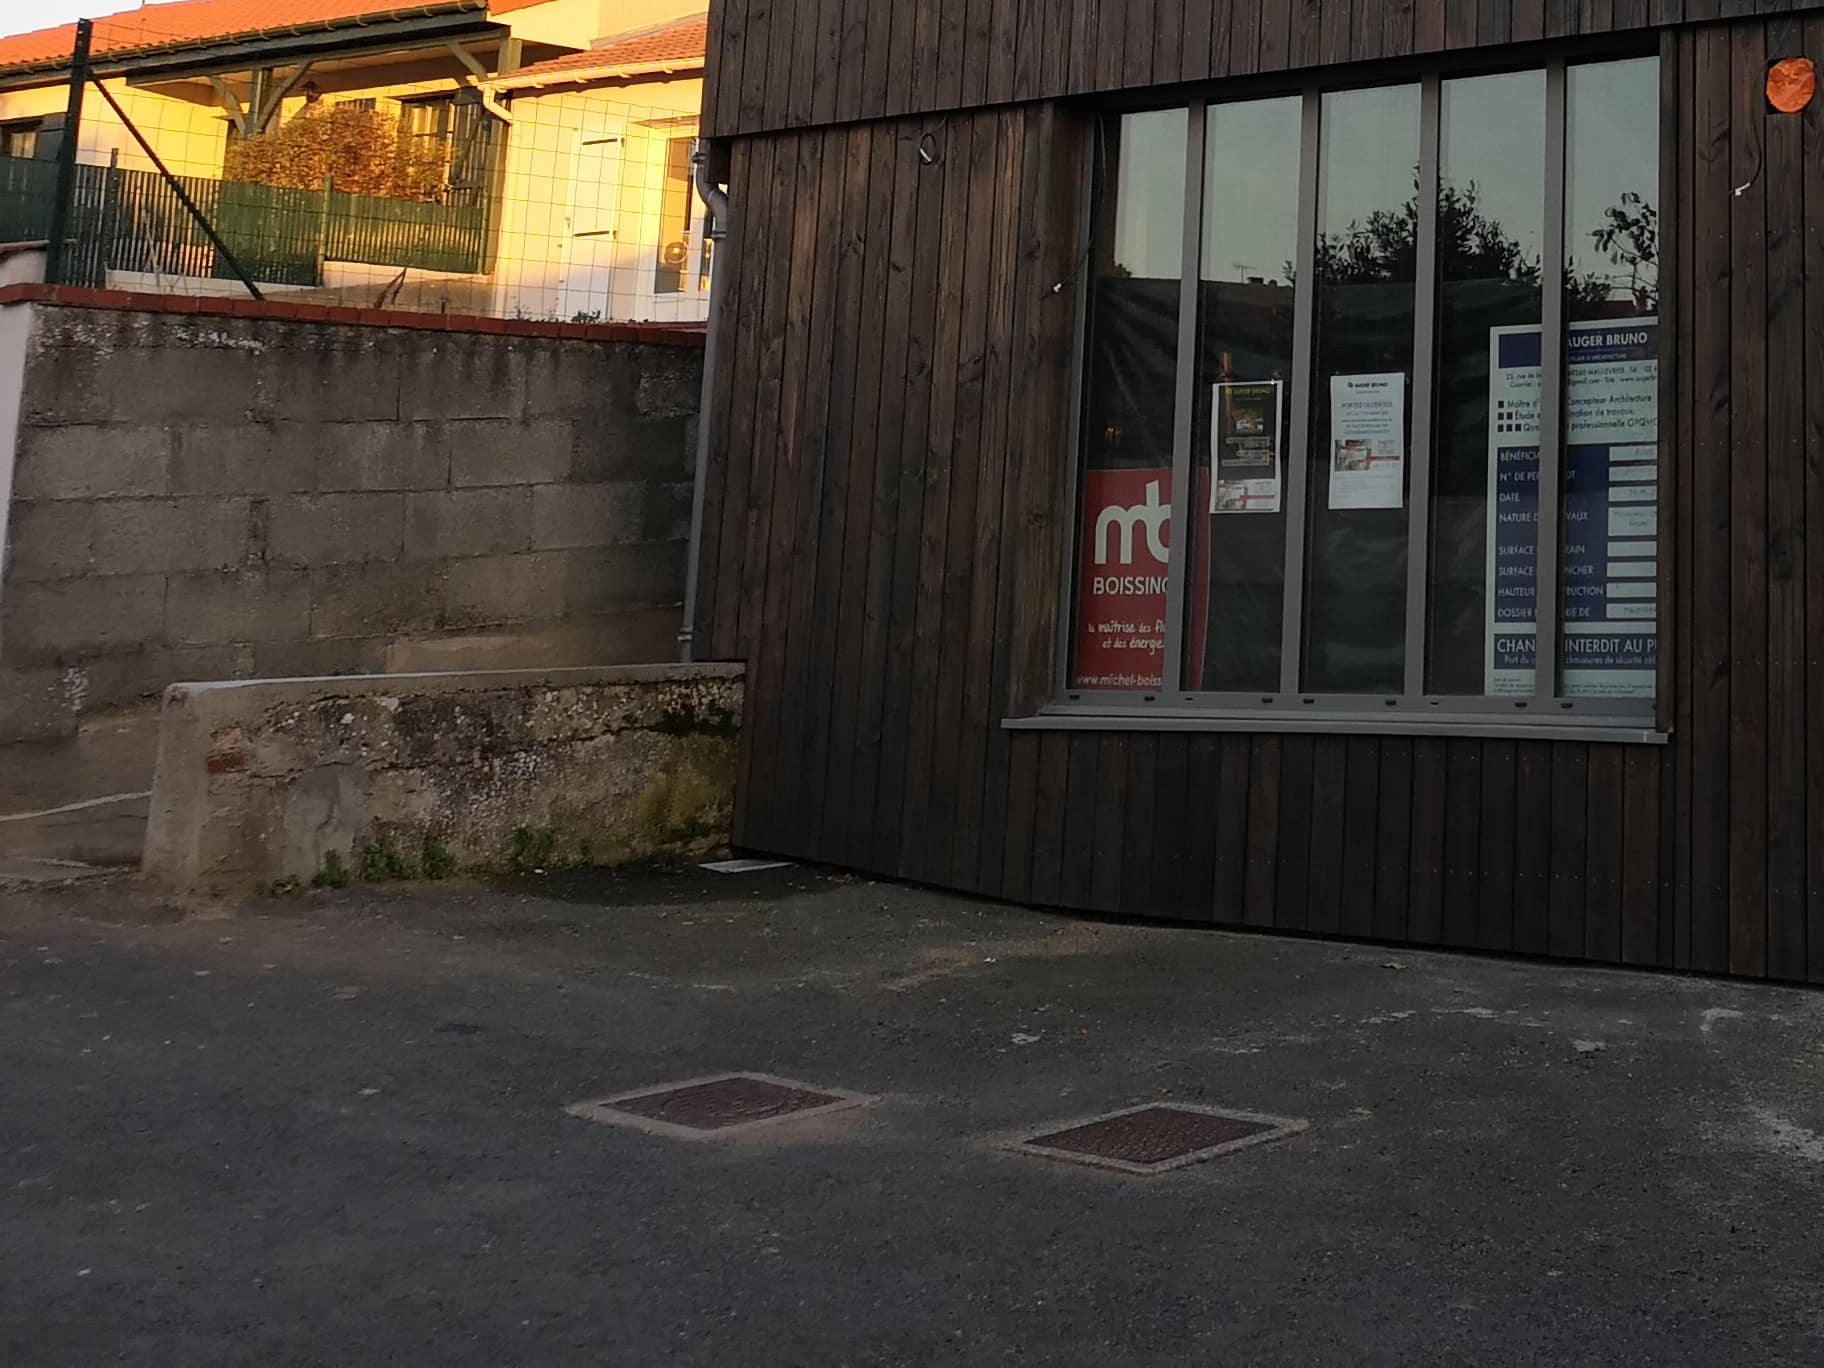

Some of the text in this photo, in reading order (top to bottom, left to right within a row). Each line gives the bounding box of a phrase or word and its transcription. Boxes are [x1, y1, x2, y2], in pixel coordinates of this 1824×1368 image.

[1568, 331, 1648, 349] AUGER BRUNO
[1514, 471, 1525, 481] DE
[1499, 492, 1520, 502] DATE
[1499, 512, 1588, 523] NATURE VAUX
[1498, 544, 1535, 555] SURFACE
[1499, 565, 1593, 576] SURFACE NCHER
[1498, 585, 1603, 597] HAUTEUR RUCTION
[1498, 607, 1531, 618] DOSSIER
[1579, 607, 1590, 617] DE
[1496, 638, 1535, 653] CHAN
[1564, 638, 1620, 653] INTERDIT
[1624, 639, 1645, 653] AU
